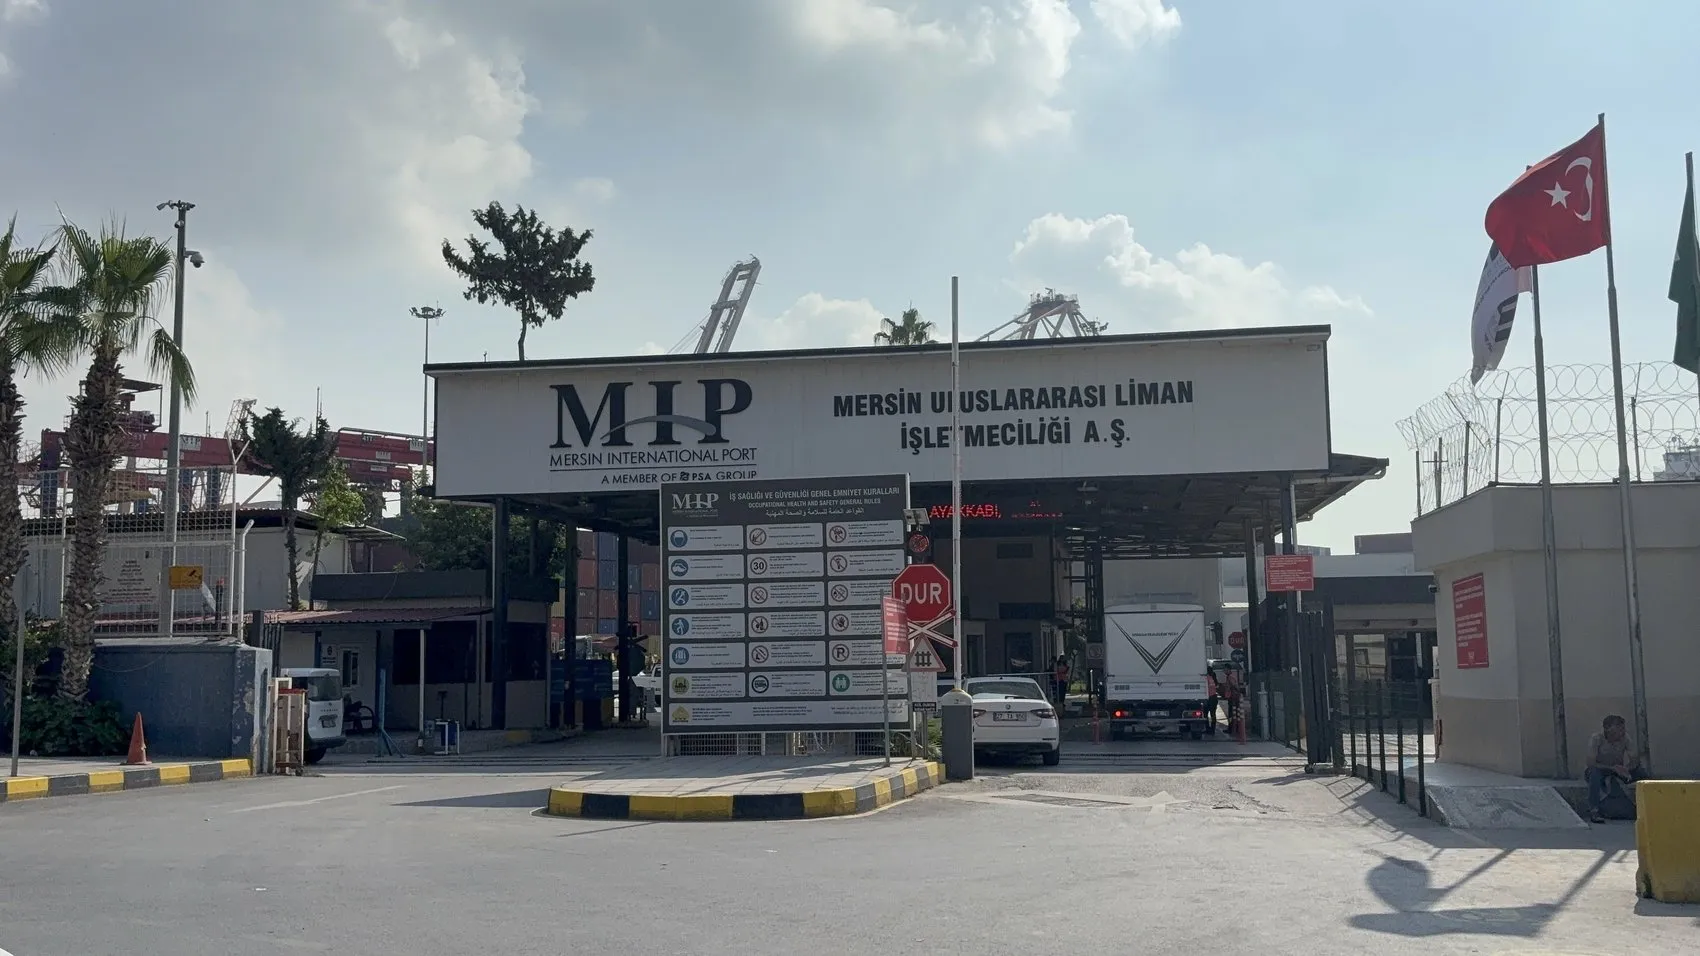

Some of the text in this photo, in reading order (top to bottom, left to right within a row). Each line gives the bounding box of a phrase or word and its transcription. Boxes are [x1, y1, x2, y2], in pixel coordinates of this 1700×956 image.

[833, 388, 922, 417] MERSİN
[1115, 378, 1194, 407] LİMAN
[549, 379, 753, 448] MIP
[550, 447, 757, 467] MERSIN INTERNATIONAL PORT
[601, 470, 757, 485] A MEMBER OF PSA GROUP
[672, 493, 719, 509] MIP
[765, 491, 773, 499] VE
[811, 490, 832, 498] GENEL
[863, 487, 900, 496] KURALLARI
[901, 583, 942, 605] DUR
